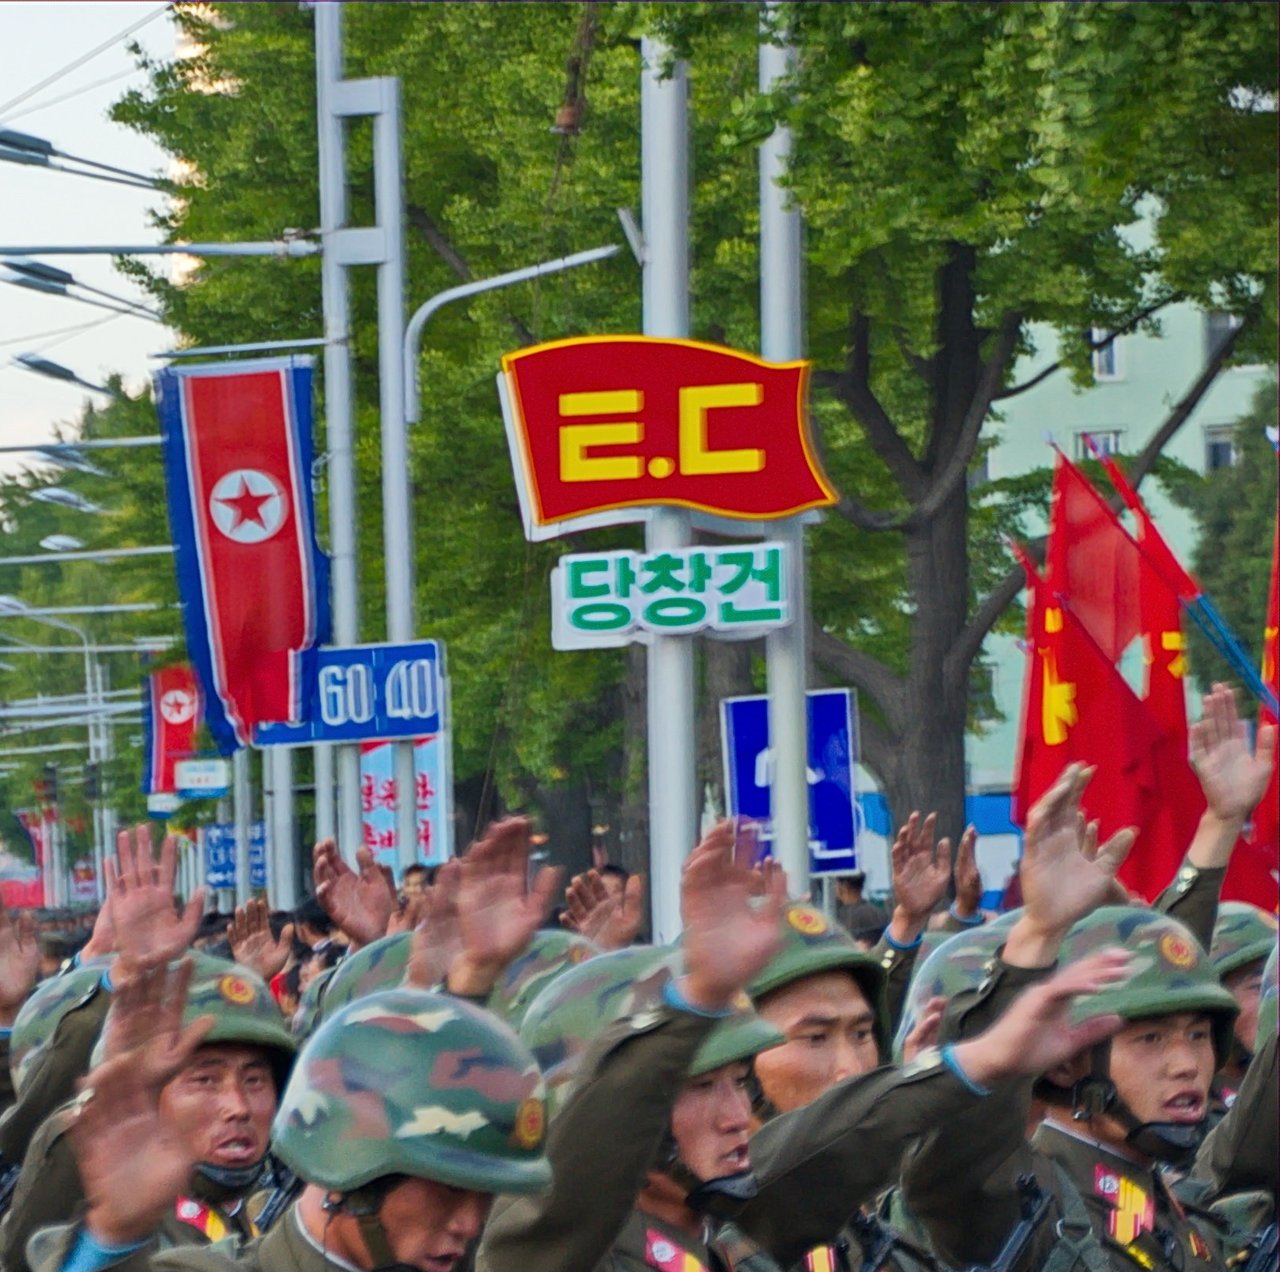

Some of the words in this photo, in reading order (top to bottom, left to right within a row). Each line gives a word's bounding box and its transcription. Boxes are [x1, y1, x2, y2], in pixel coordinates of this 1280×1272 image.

[567, 549, 782, 631] 당창건
[318, 664, 375, 726] 60
[385, 659, 438, 720] 40
